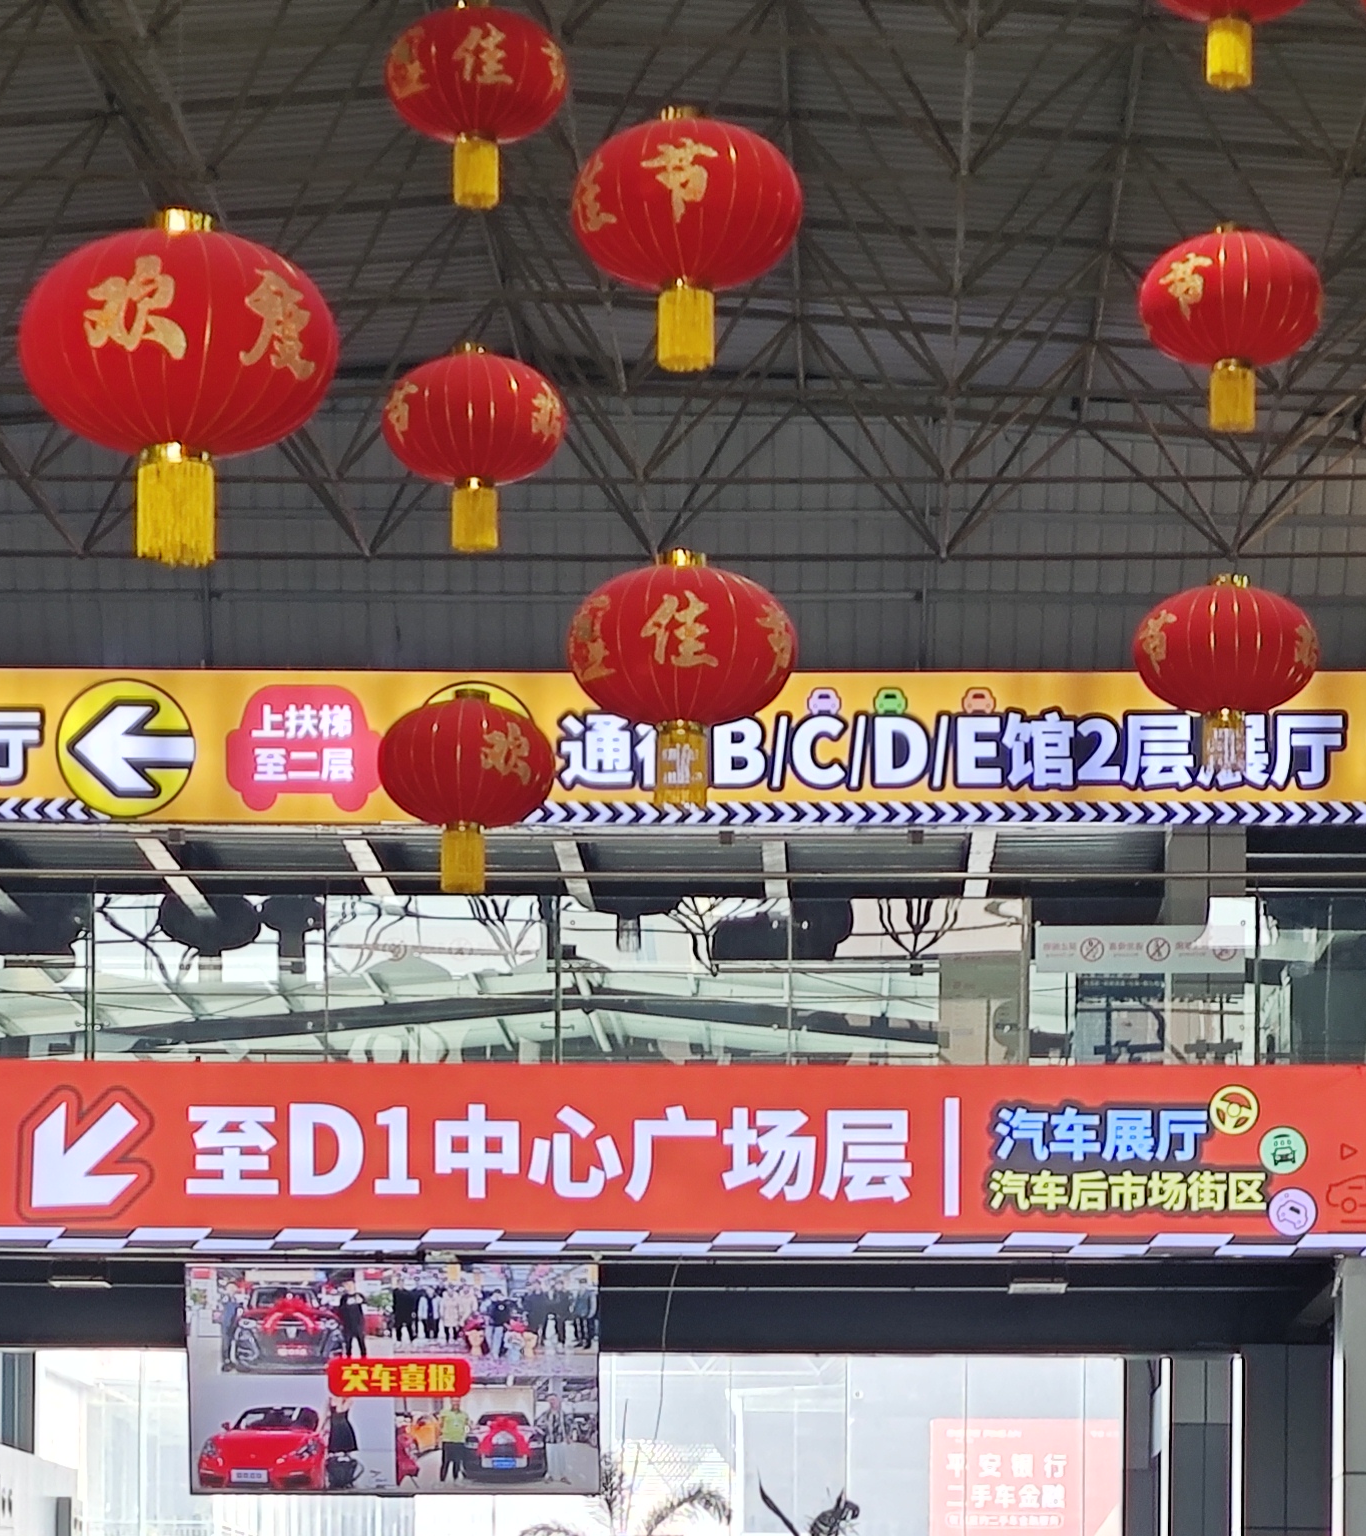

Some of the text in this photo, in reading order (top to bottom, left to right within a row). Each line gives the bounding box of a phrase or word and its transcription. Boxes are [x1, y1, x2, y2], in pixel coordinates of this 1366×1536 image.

[250, 703, 353, 740] 上扶梯
[253, 746, 354, 784] 至二层
[186, 1102, 914, 1203] 至D1中心广场层
[995, 1106, 1209, 1162] 汽车展厅
[988, 1170, 1268, 1212] 汽车后市场街区
[340, 1362, 458, 1394] 交车喜报
[945, 1452, 1068, 1479] 平安银行
[945, 1483, 1066, 1509] 二手车金融
